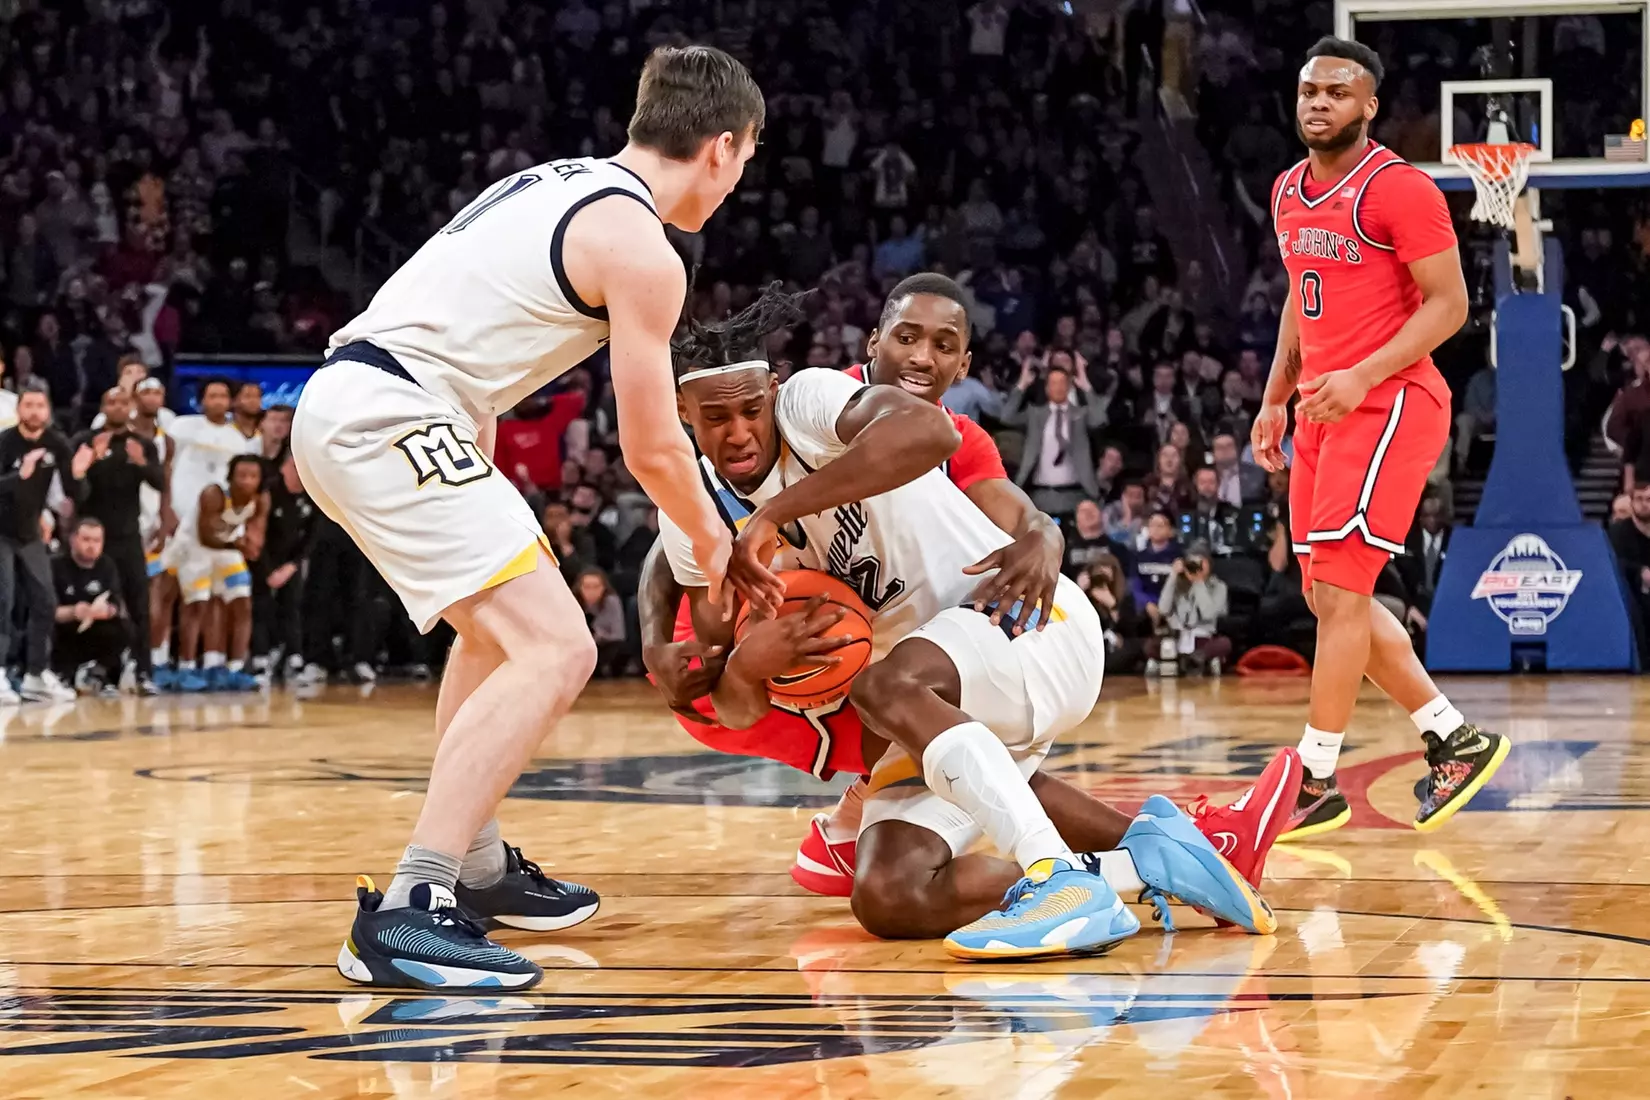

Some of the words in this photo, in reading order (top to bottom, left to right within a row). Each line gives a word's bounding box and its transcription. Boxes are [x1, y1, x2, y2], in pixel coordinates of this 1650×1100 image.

[1291, 227, 1363, 265] JOHN'S
[1300, 269, 1323, 320] 0
[391, 422, 494, 488] MU
[827, 500, 868, 577] uette
